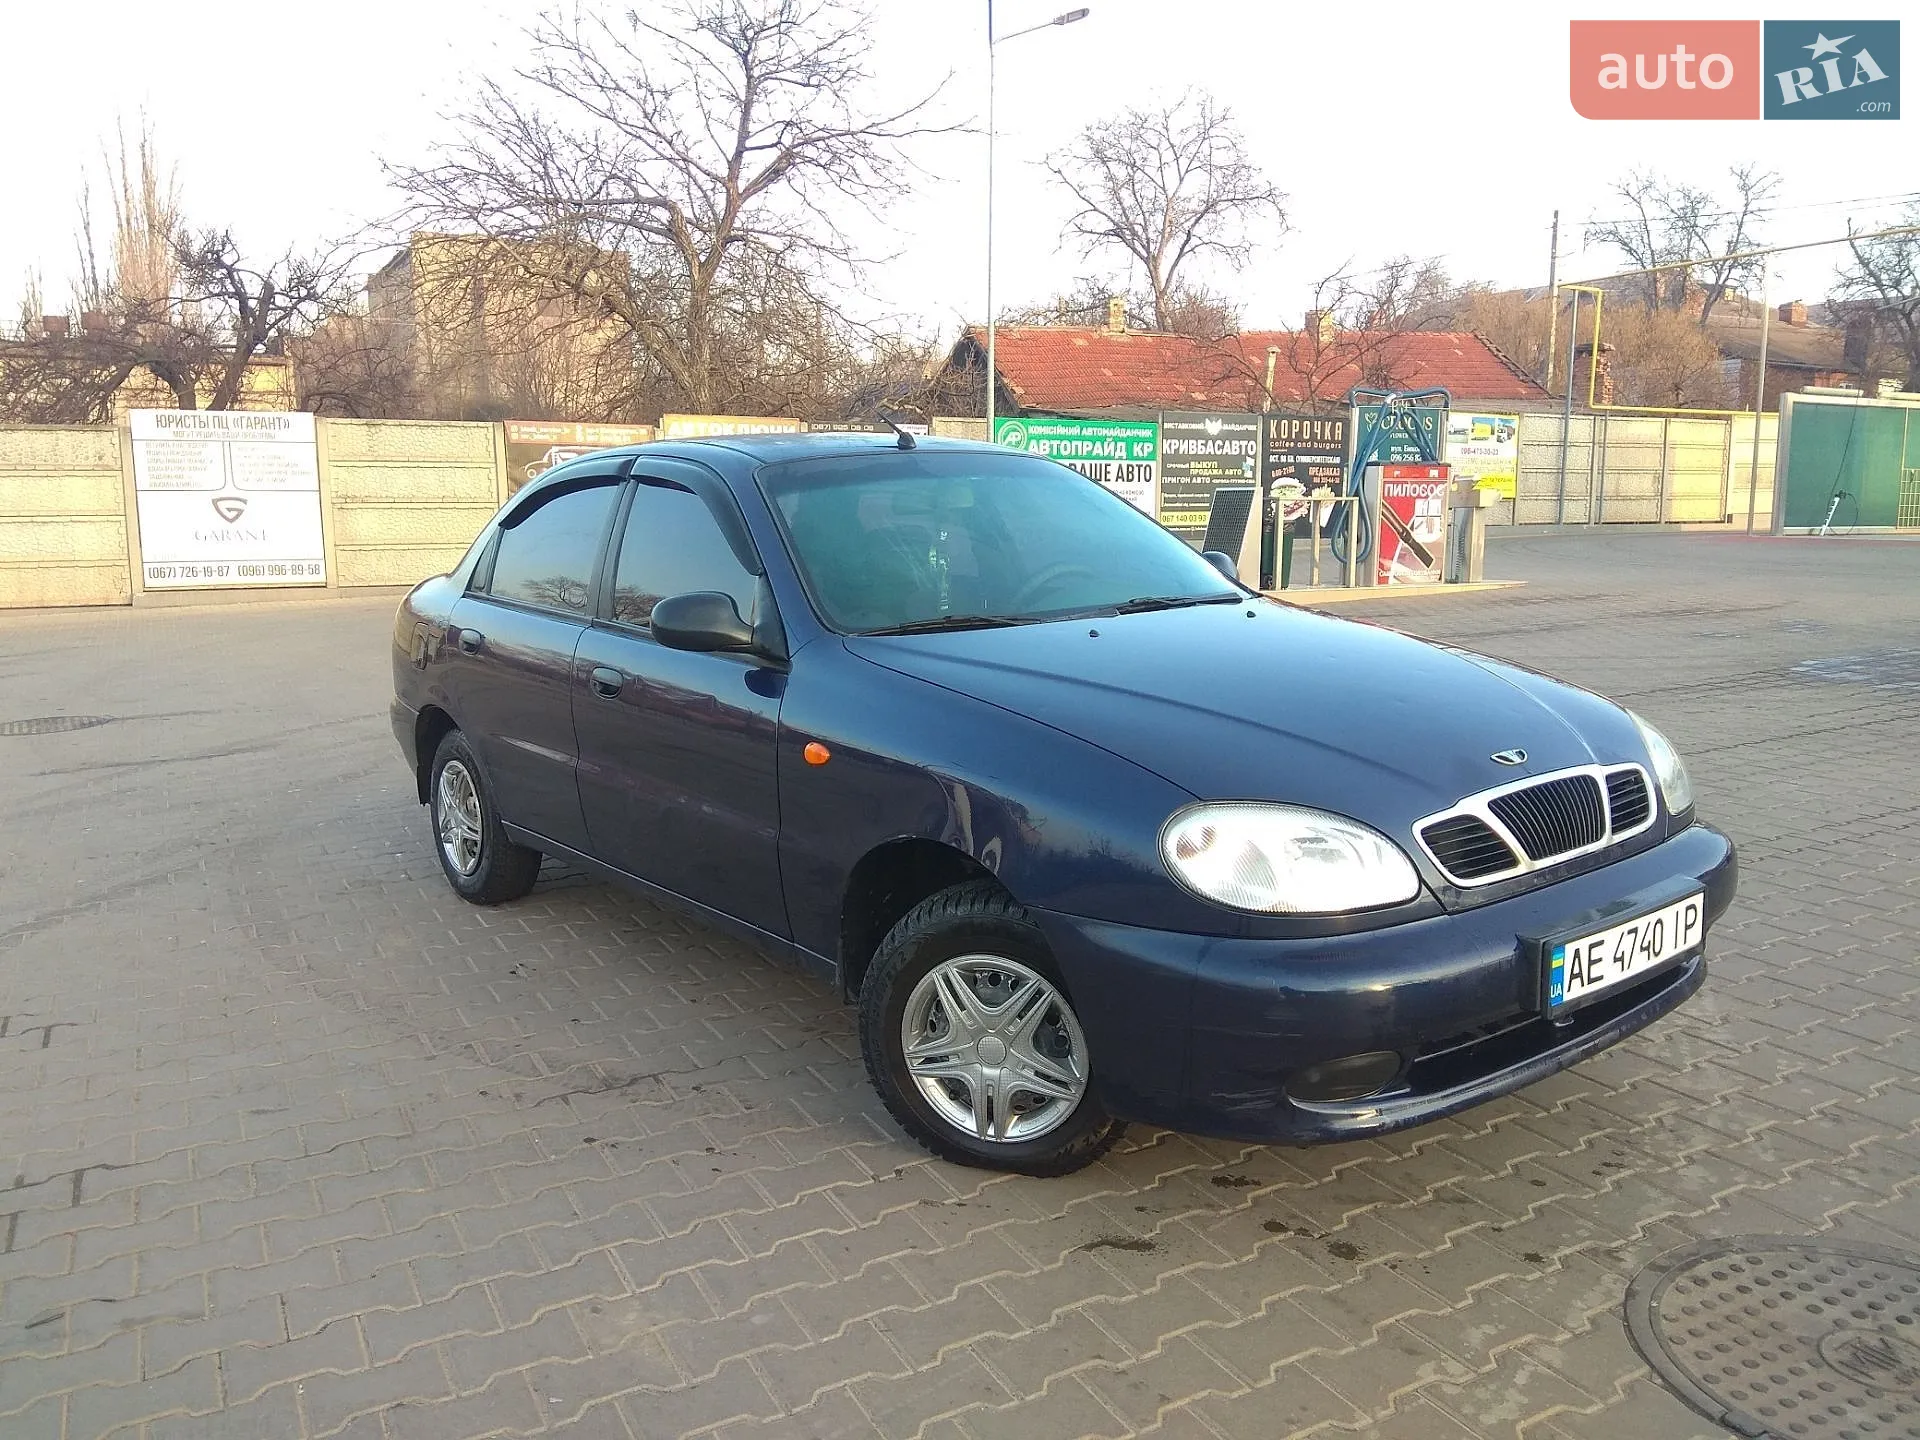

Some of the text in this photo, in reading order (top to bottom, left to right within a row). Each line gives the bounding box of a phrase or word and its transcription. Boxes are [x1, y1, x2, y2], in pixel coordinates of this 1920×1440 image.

[155, 414, 210, 429] ЮРИСТЫ
[212, 415, 230, 430] ПЦ
[1269, 419, 1342, 440] КОРОЧКА
[1028, 425, 1153, 438] КОМІСІЙНИЙ АВТОМАЙДАНЧИК
[1028, 437, 1154, 459] АВТОПРАЙД КР
[1162, 439, 1257, 455] КРИВБАСАВТО
[1269, 440, 1295, 448] coffee
[1313, 441, 1342, 450] burgers
[1115, 463, 1152, 483] АВТО
[1190, 461, 1218, 469] ВЫКУП
[1190, 468, 1222, 476] ПРОДАЖА
[1162, 476, 1190, 484] ПРИГОН
[1192, 476, 1211, 484] АВТО
[148, 563, 321, 579] (067) 726-19-87 (096) 996-89-58
[1567, 903, 1698, 993] AE 4740 IP
[1550, 984, 1562, 998] UA
